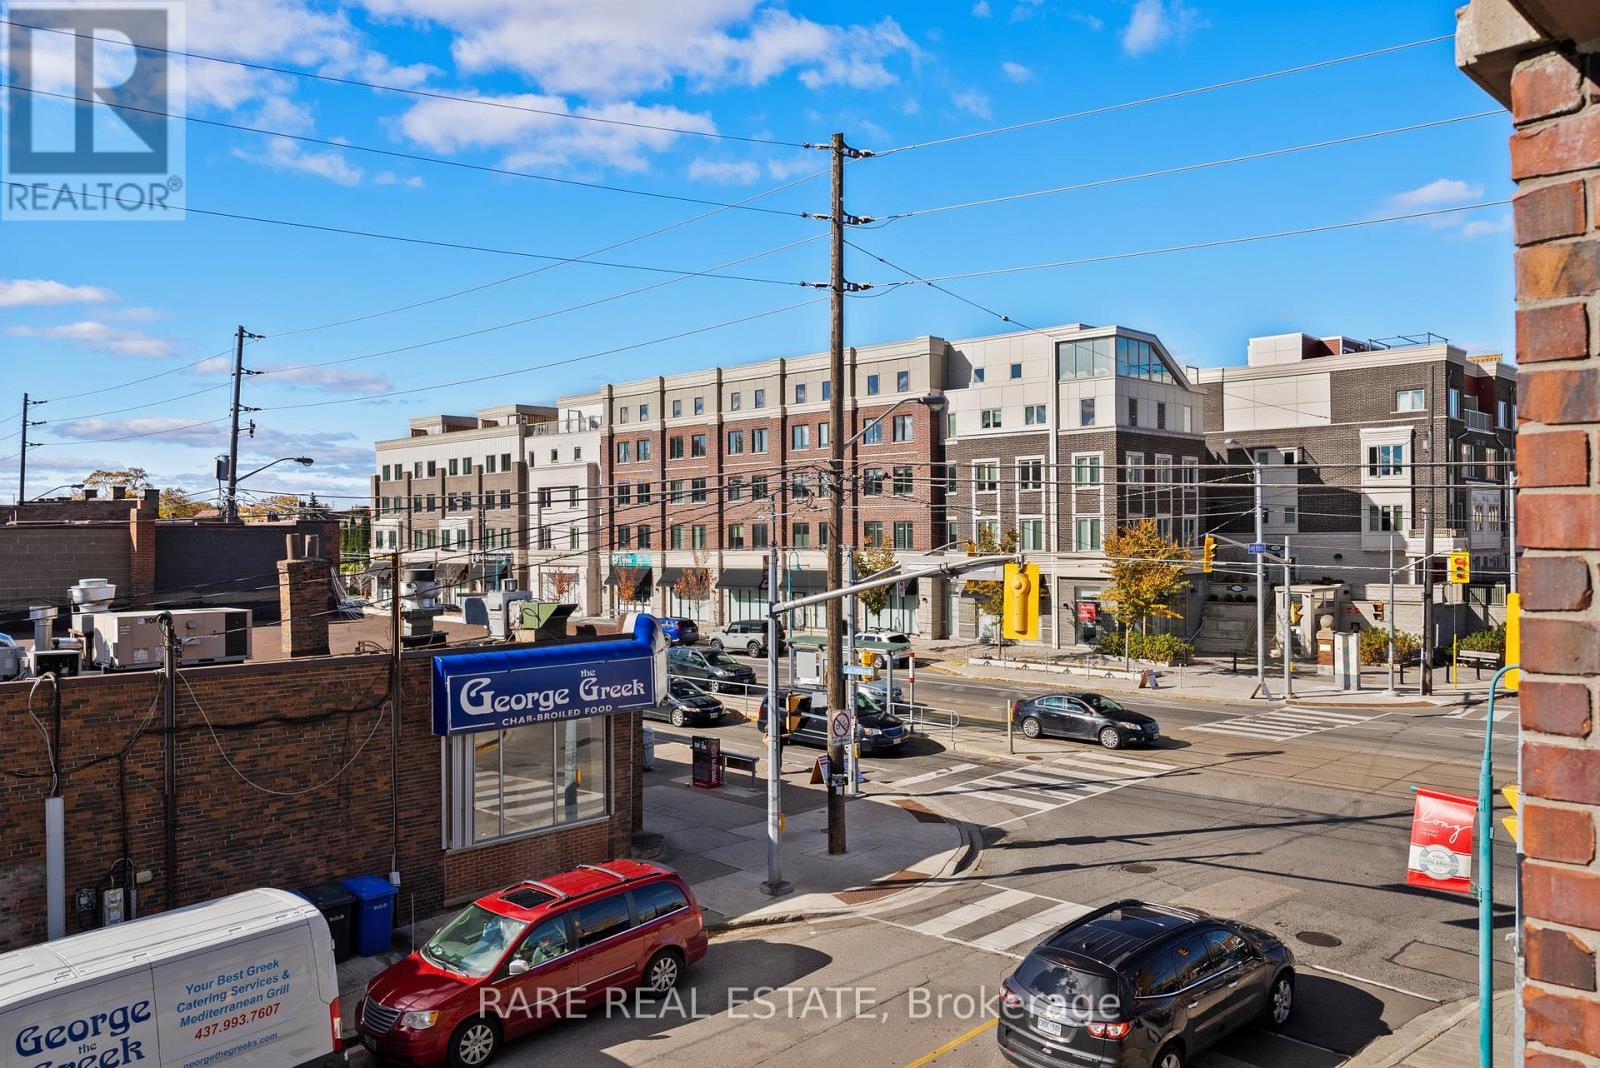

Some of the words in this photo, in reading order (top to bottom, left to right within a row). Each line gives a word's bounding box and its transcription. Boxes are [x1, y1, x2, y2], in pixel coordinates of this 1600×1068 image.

[580, 669, 596, 678] the
[460, 677, 570, 716] George
[579, 677, 646, 701] Greek
[502, 709, 581, 727] CHAR-BROILED
[585, 704, 613, 715] FOOD
[176, 989, 227, 1013] Catering
[230, 975, 279, 996] Services
[281, 969, 291, 980] &
[186, 978, 214, 995] Your
[217, 970, 244, 986] Best
[246, 959, 280, 977] Greek
[179, 993, 263, 1028] Mediterranean
[266, 983, 290, 999] Grill
[194, 1002, 281, 1041] 437.993.7607
[15, 1000, 151, 1057] George
[33, 1037, 146, 1068] eek
[78, 1042, 98, 1055] the
